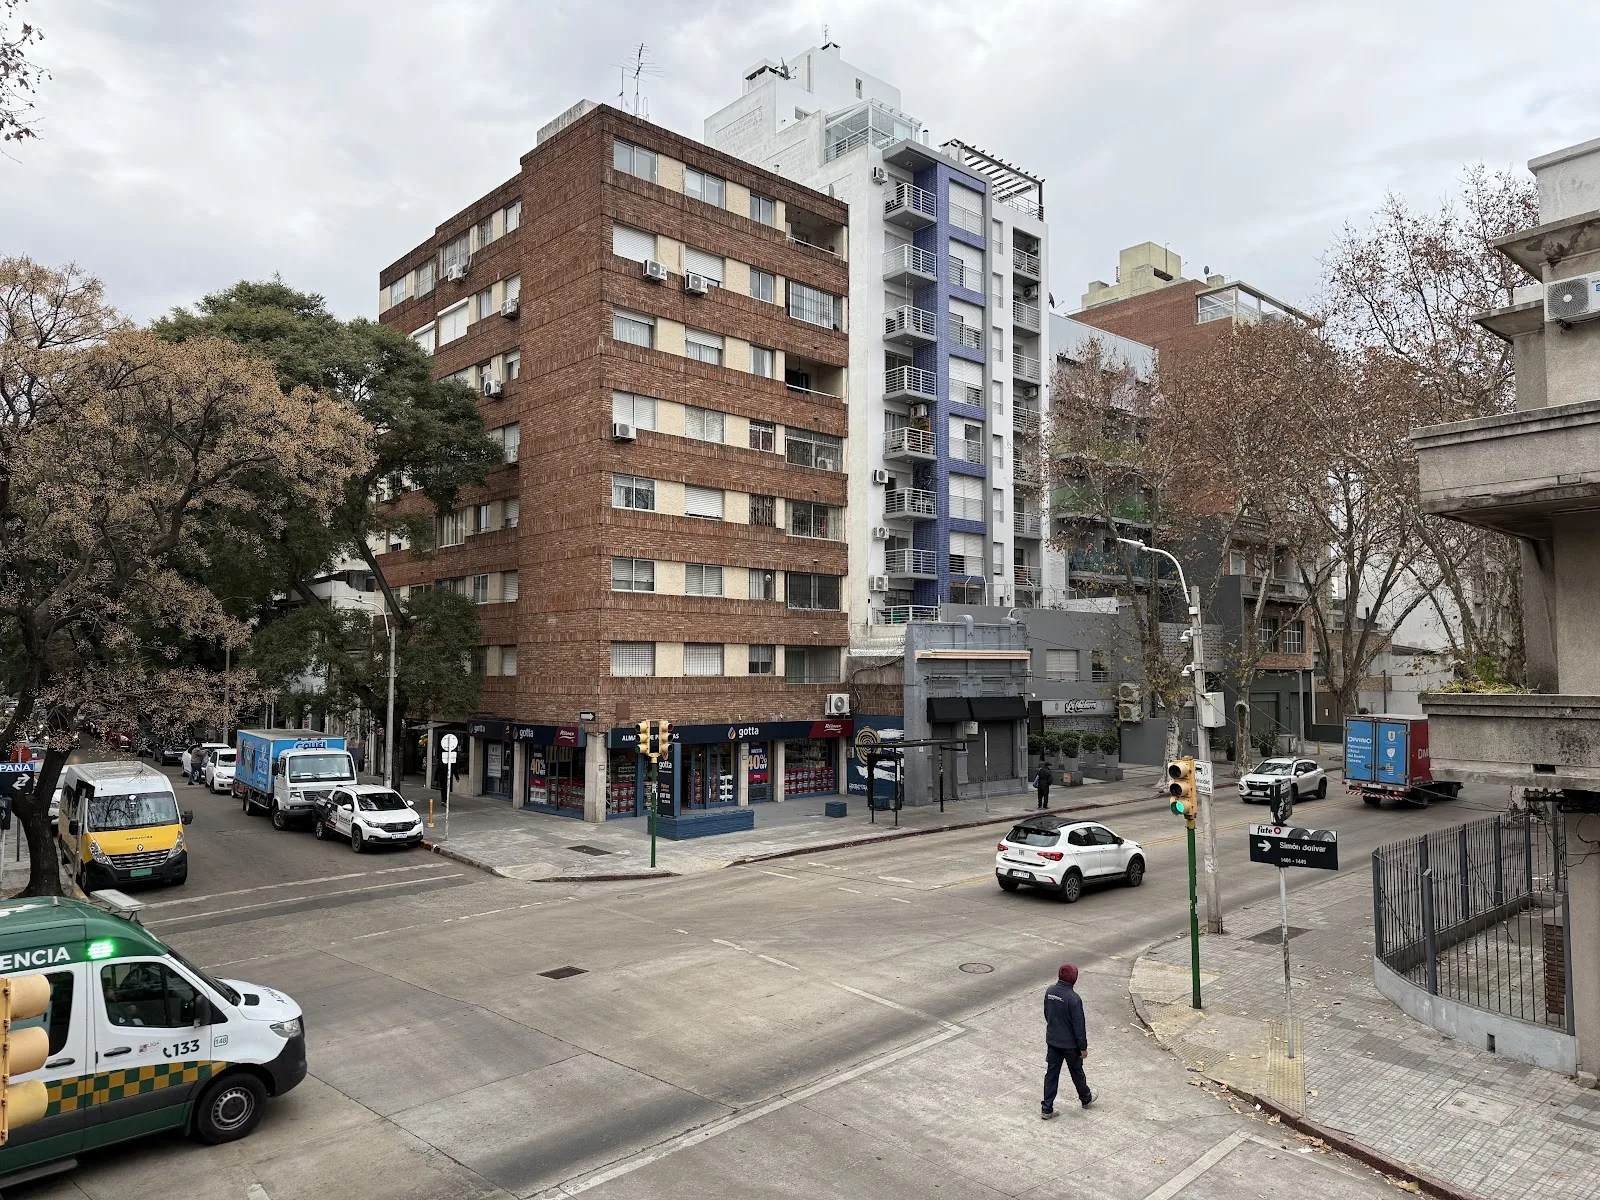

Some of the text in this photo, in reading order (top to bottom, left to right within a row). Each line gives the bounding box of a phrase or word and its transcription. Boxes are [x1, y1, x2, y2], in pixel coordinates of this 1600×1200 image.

[474, 725, 486, 733] gotta
[520, 728, 533, 739] gotta
[739, 727, 759, 739] gotta
[659, 761, 673, 770] gotta
[1257, 826, 1273, 834] fate
[1279, 842, 1301, 851] Simón
[173, 1039, 200, 1057] 133
